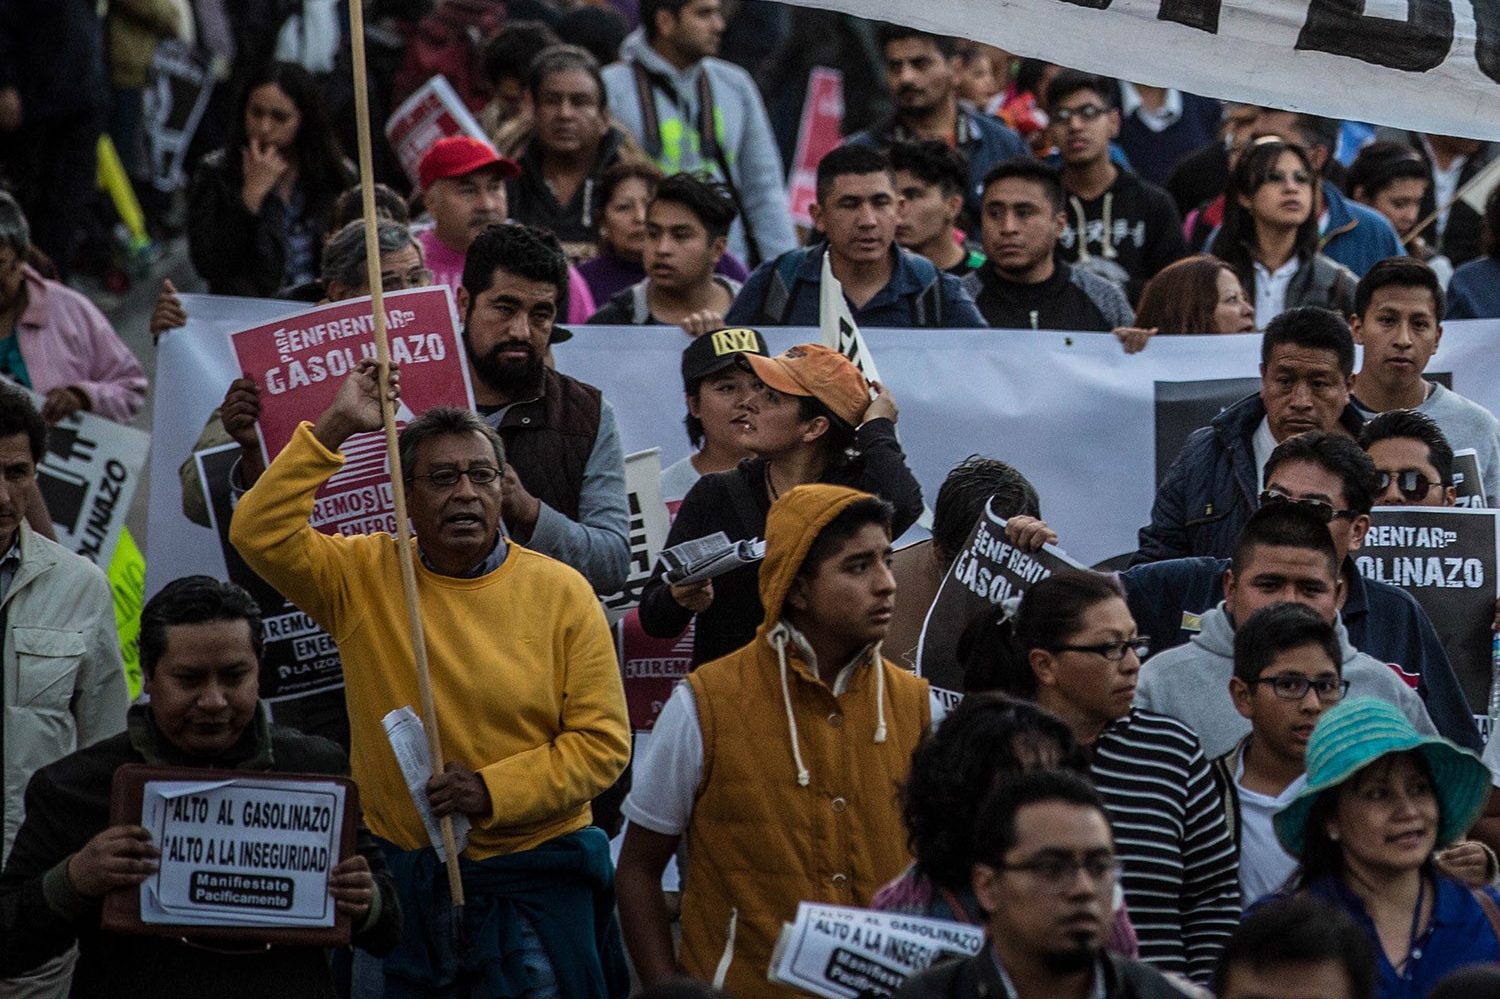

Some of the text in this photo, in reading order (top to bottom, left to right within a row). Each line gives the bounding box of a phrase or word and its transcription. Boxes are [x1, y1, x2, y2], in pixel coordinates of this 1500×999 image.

[273, 327, 294, 363] PARA
[713, 330, 758, 353] NY
[216, 799, 235, 825] AL
[242, 801, 331, 833] GASOLINAZO
[205, 840, 216, 865] A
[219, 840, 236, 866] LA
[239, 842, 328, 873] INSEGURIDAD
[194, 888, 290, 908] Pacificamente
[195, 872, 291, 893] Manifiestate
[814, 919, 851, 940] ALTO
[852, 927, 862, 944] A
[864, 930, 881, 954] LA
[889, 919, 981, 953] GASOLINAZO
